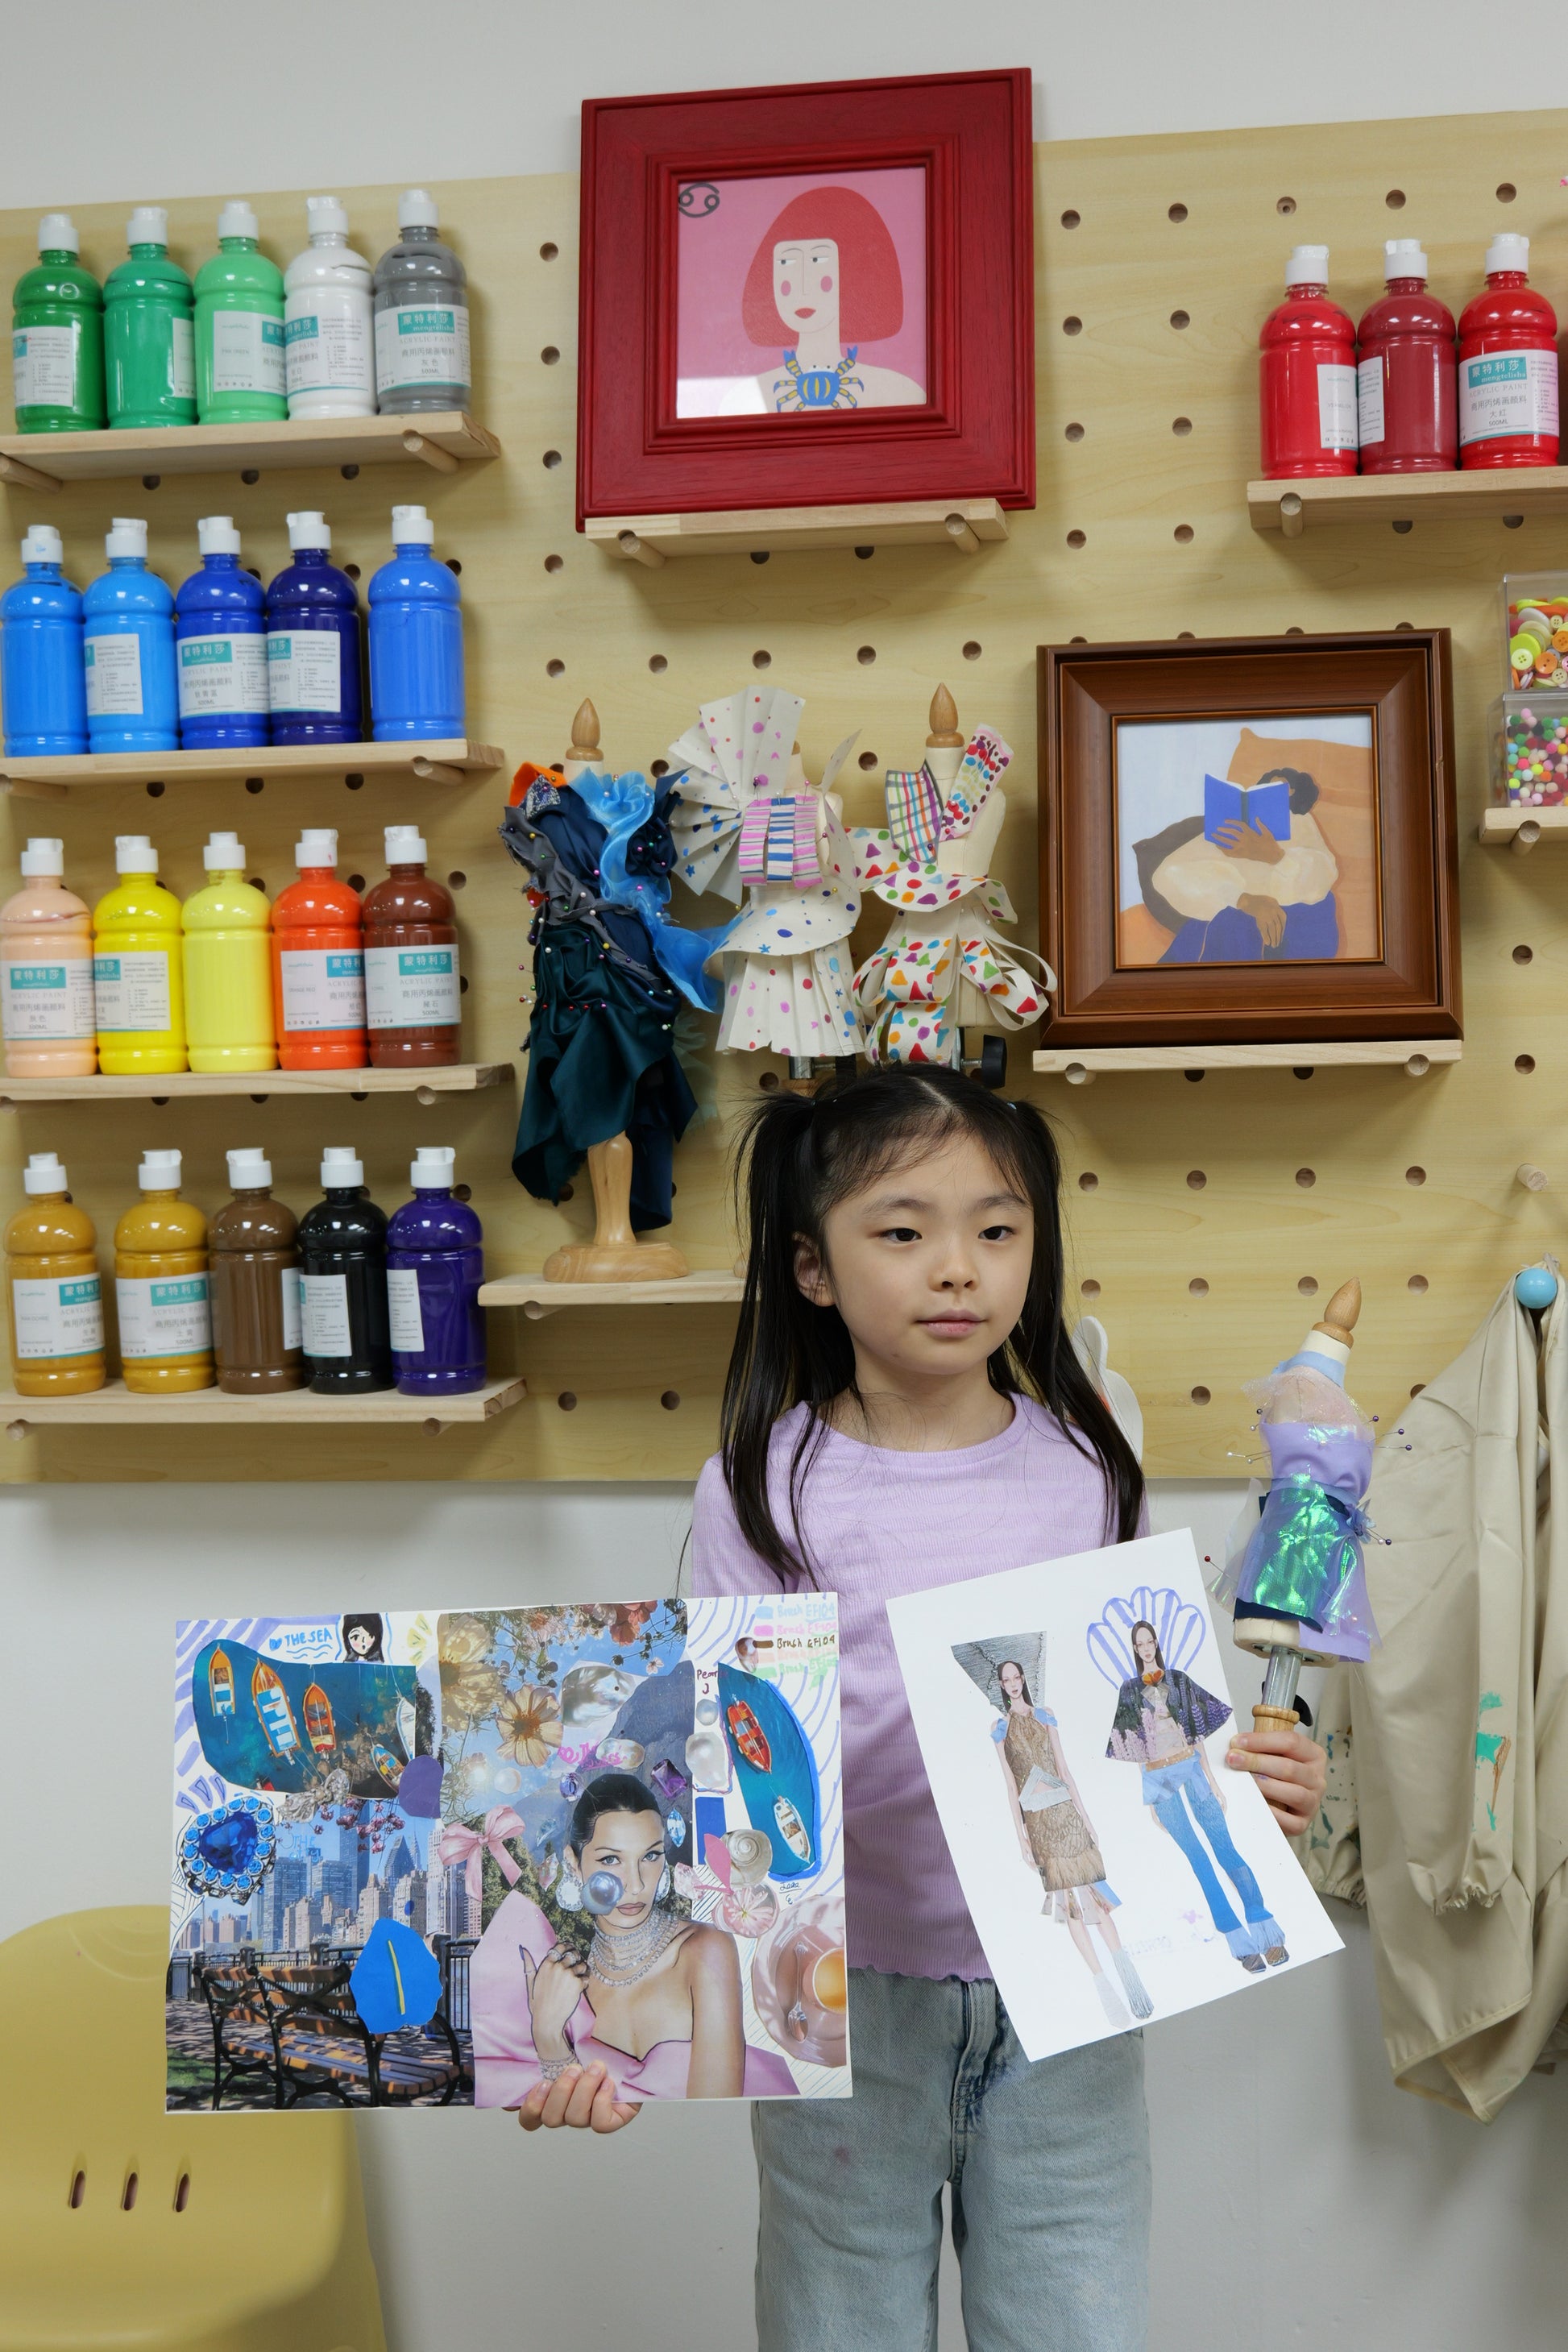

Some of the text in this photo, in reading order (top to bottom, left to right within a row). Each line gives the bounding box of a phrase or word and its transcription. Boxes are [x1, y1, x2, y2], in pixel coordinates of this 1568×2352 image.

[403, 313, 450, 326] 蒙特利莎
[399, 334, 457, 344] ACRYLIC PAINT
[1472, 360, 1520, 378] 蒙特利莎
[1481, 371, 1526, 384] mengtelisha
[1469, 383, 1529, 399] ACRYLIC PAINT
[1489, 409, 1507, 419] 大红
[1489, 419, 1509, 427] 500ML
[185, 643, 225, 657] 蒙特利莎
[209, 665, 233, 674] PAINT
[404, 953, 449, 967] 蒙特利莎
[14, 969, 60, 981] 蒙特利莎
[327, 979, 356, 988] ACRYLIC
[400, 978, 432, 986] ACRYLIC
[43, 991, 67, 999] PAINT
[156, 1282, 202, 1297] 蒙特利莎
[153, 1307, 187, 1316] ACRYLIC
[284, 1628, 333, 1646] THE SEA
[777, 1637, 803, 1649] Brush
